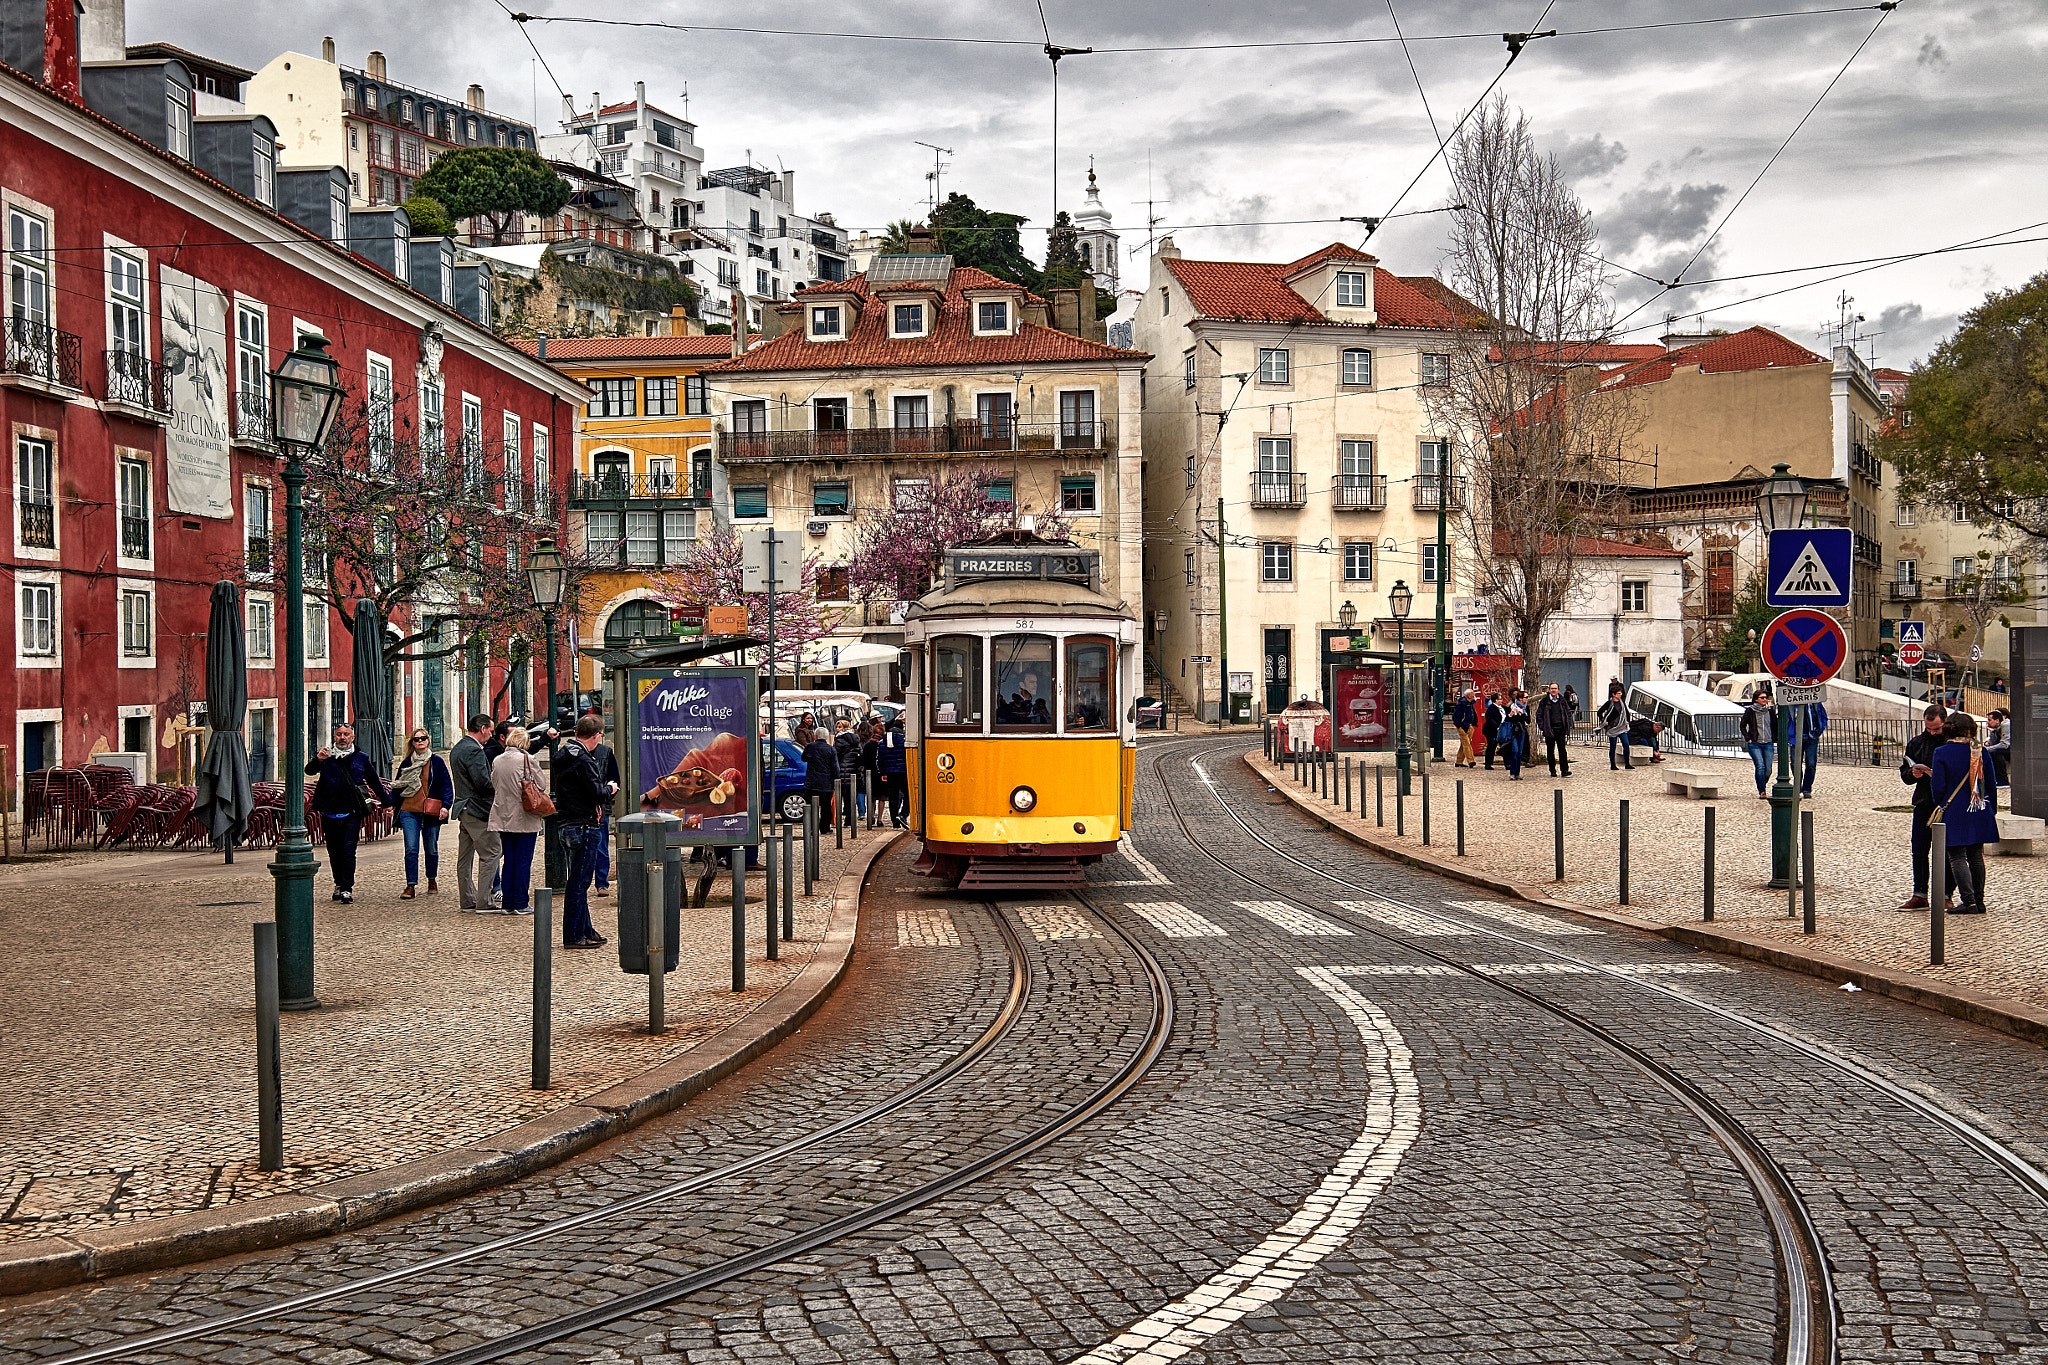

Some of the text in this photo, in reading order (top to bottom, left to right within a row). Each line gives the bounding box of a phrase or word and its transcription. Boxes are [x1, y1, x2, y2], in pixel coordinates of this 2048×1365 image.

[170, 409, 226, 441] OFICINAS
[960, 557, 1079, 574] PRAZERES 28
[1015, 619, 1034, 629] 582
[1900, 650, 1923, 658] STOP
[640, 681, 657, 697] NOVO
[1782, 686, 1821, 696] EXCEPTO
[656, 685, 710, 712] Milka
[1786, 693, 1819, 703] CARRIS
[689, 704, 733, 720] Collage
[672, 725, 712, 733] combinação
[652, 733, 693, 741] ingredientes
